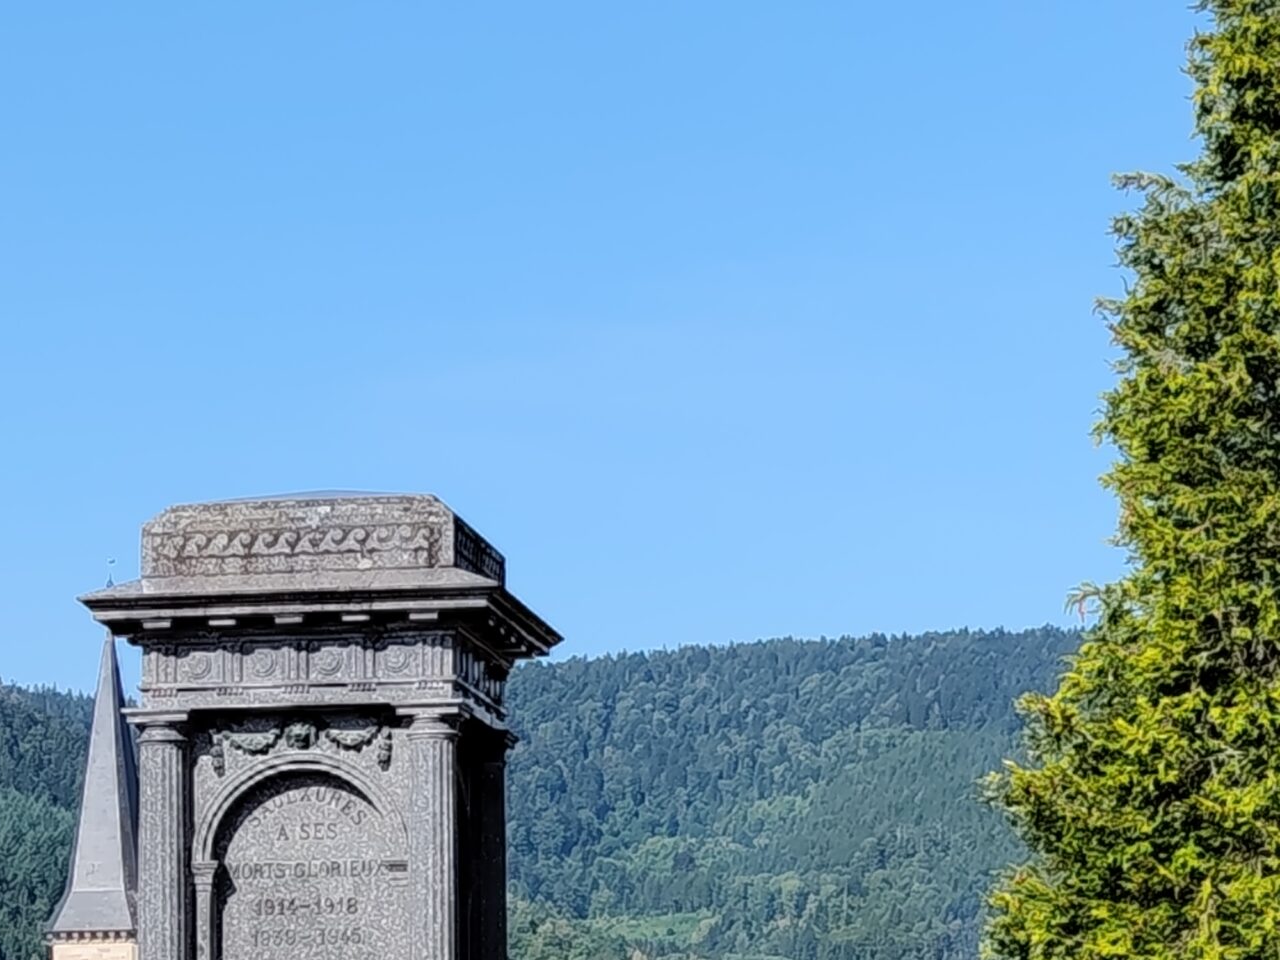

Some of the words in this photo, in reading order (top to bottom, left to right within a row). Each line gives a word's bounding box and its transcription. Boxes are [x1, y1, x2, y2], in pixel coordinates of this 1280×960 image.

[276, 822, 290, 841] A
[299, 822, 338, 841] SES
[229, 861, 287, 881] MORTS
[293, 859, 385, 880] GLORIEUX
